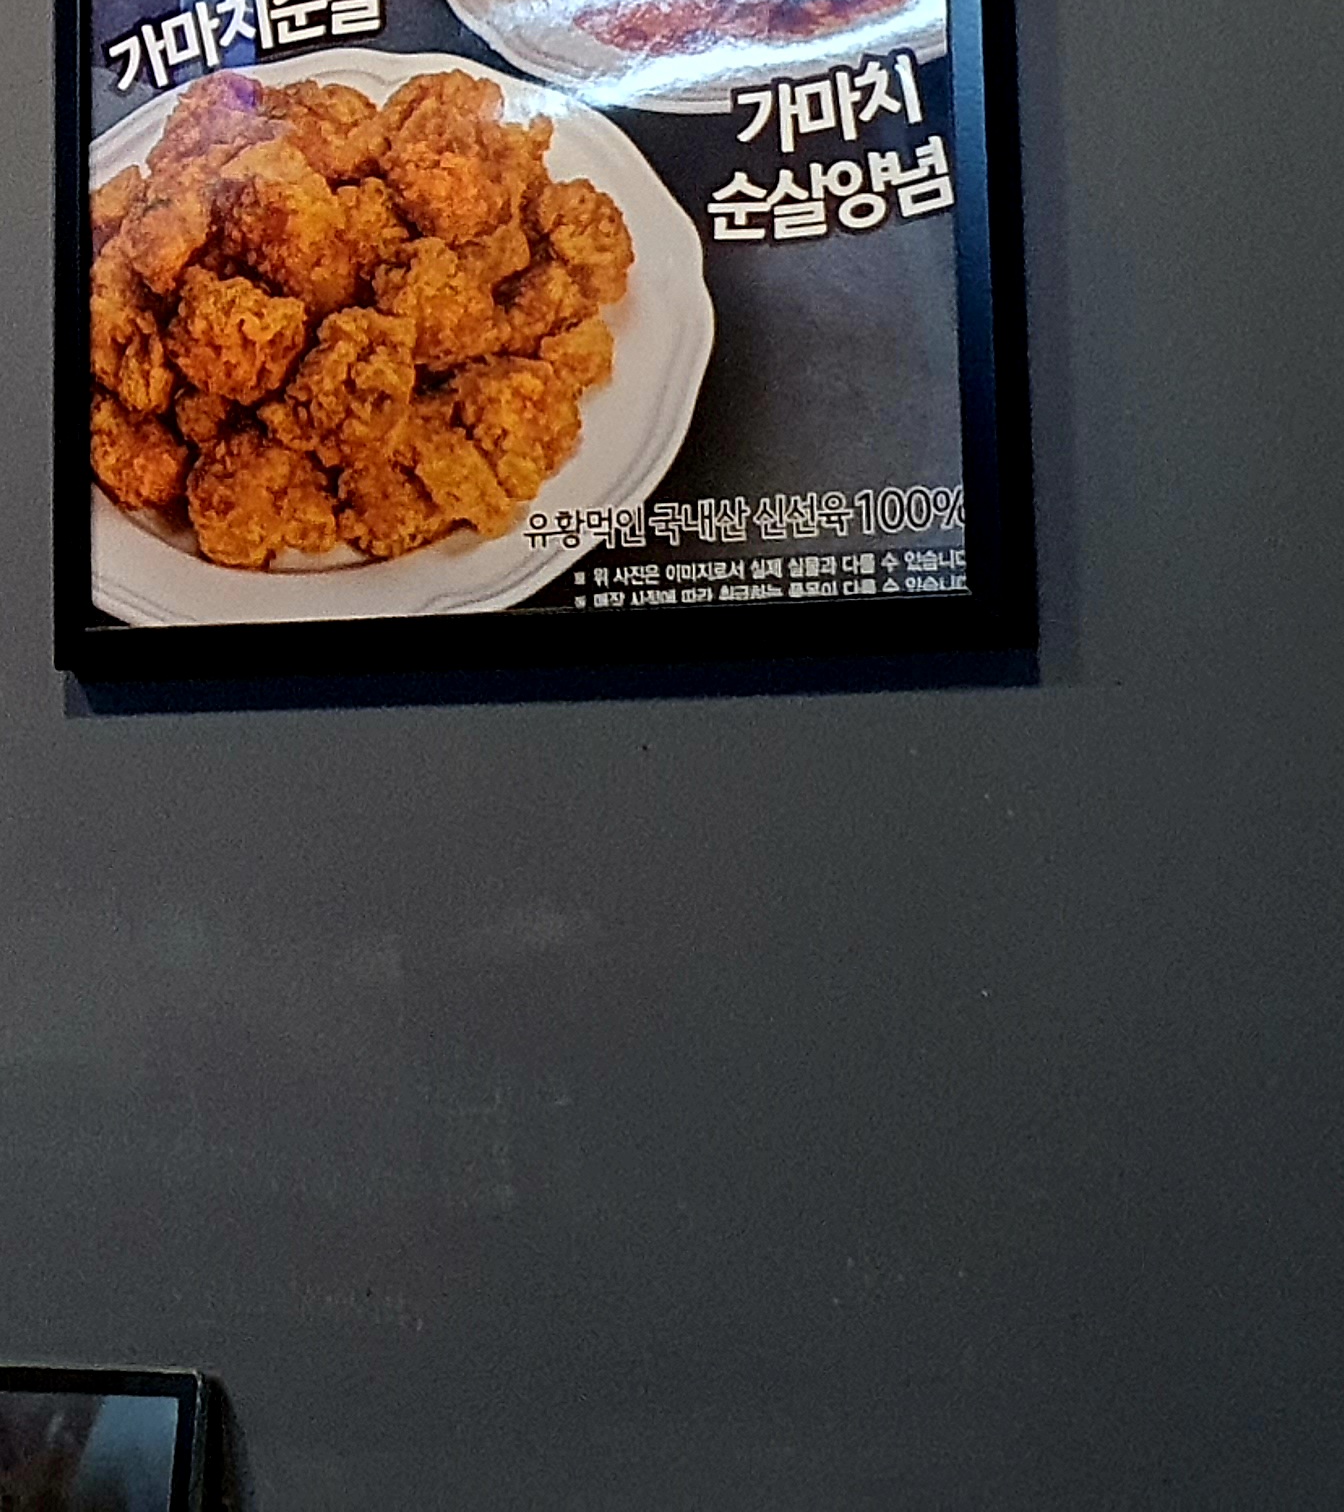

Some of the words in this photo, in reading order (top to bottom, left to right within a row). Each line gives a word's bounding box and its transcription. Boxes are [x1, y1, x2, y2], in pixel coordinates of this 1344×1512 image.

[737, 55, 921, 153] 가마치
[707, 138, 954, 244] 순살양념
[522, 501, 647, 549] 유황먹인
[648, 496, 752, 546] 국내산
[753, 490, 853, 541] 신선육
[855, 485, 965, 536] 100%
[593, 566, 610, 588] 위
[613, 563, 660, 585] 사진은
[665, 558, 745, 583] 이미지로서
[881, 552, 900, 573] 수
